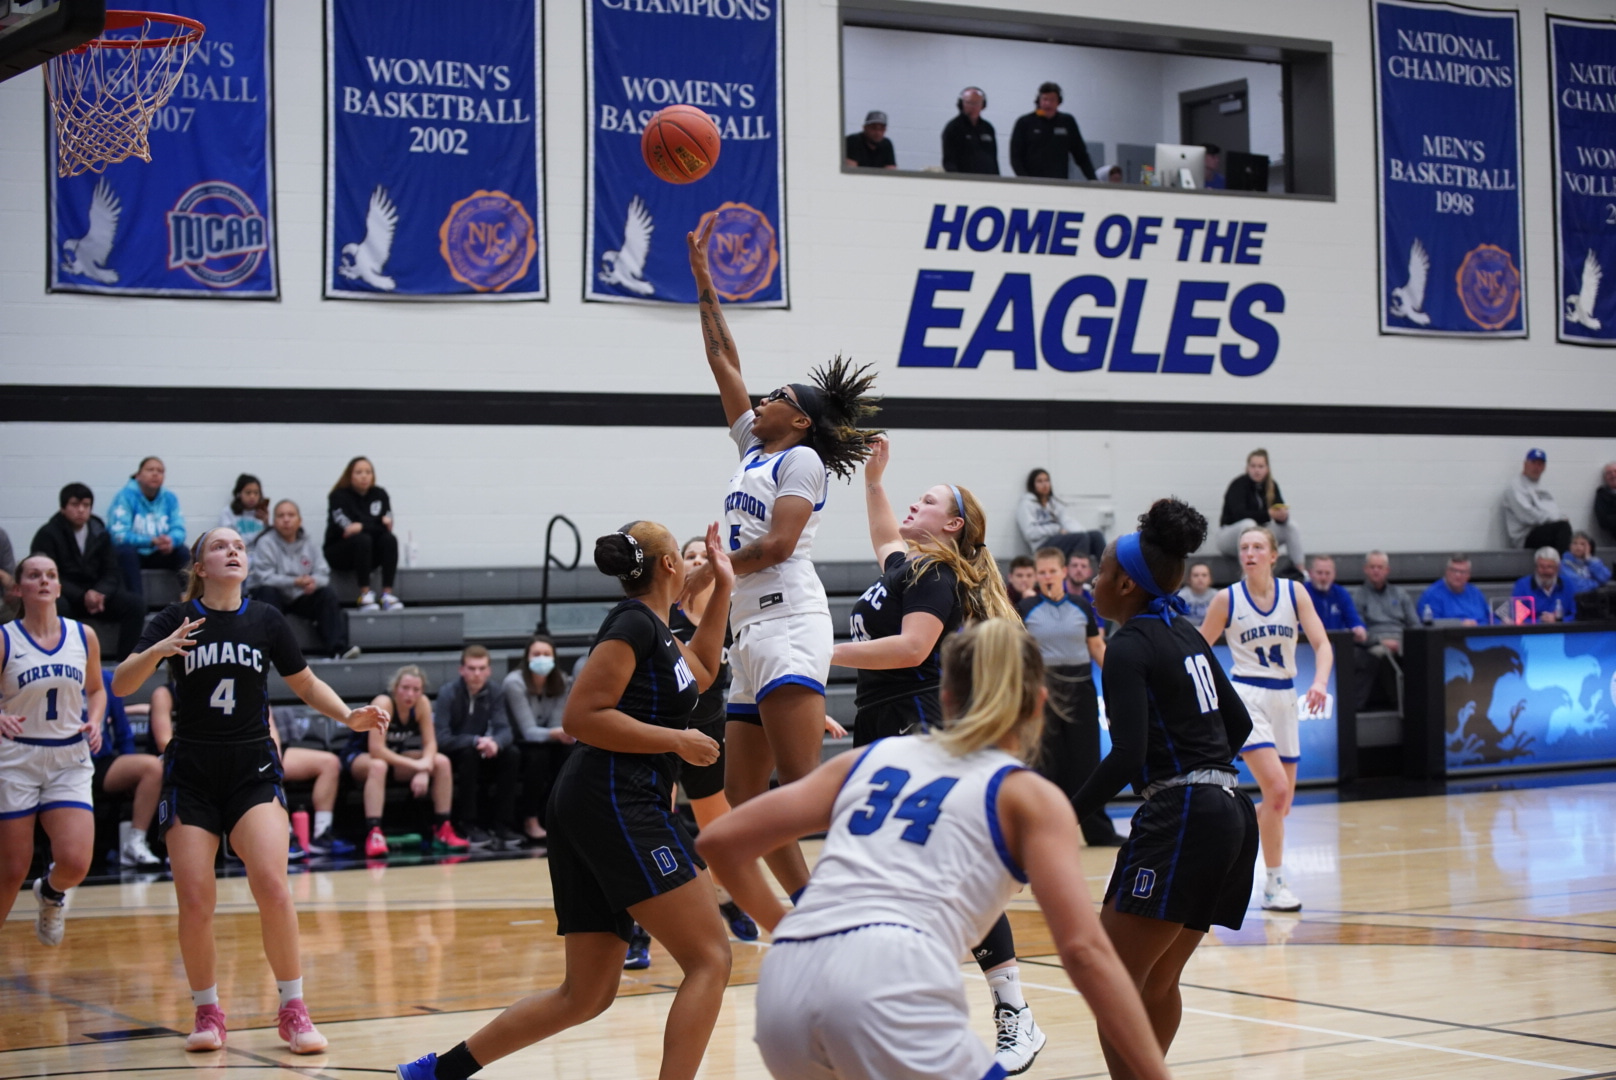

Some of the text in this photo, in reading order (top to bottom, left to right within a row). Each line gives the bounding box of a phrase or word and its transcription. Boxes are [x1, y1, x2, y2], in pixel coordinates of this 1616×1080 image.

[1397, 29, 1500, 61] NATIONAL
[365, 56, 512, 91] WOMEN'S
[1388, 56, 1512, 88] CHAMPIONS
[343, 86, 531, 125] BASKETBALL
[622, 76, 755, 108] WOMEN'S
[600, 104, 771, 140] BASBALL
[409, 127, 469, 155] 2002
[1422, 134, 1485, 162] MEN'S
[1390, 159, 1515, 190] BASKETBALL
[1436, 191, 1474, 216] 1998
[168, 212, 266, 267] NJCAA
[925, 204, 1267, 264] HOME OF THE
[897, 269, 1285, 376] EAGLES
[1240, 624, 1294, 644] KIRKWOOD
[184, 641, 263, 676] DMACC
[1254, 644, 1286, 669] 14
[17, 663, 84, 689] KIRKWOOD
[1184, 653, 1219, 714] 10
[46, 688, 58, 721] 1
[209, 678, 236, 715] 4
[847, 766, 960, 847] 34
[650, 845, 679, 876] D
[1132, 867, 1157, 899] D
